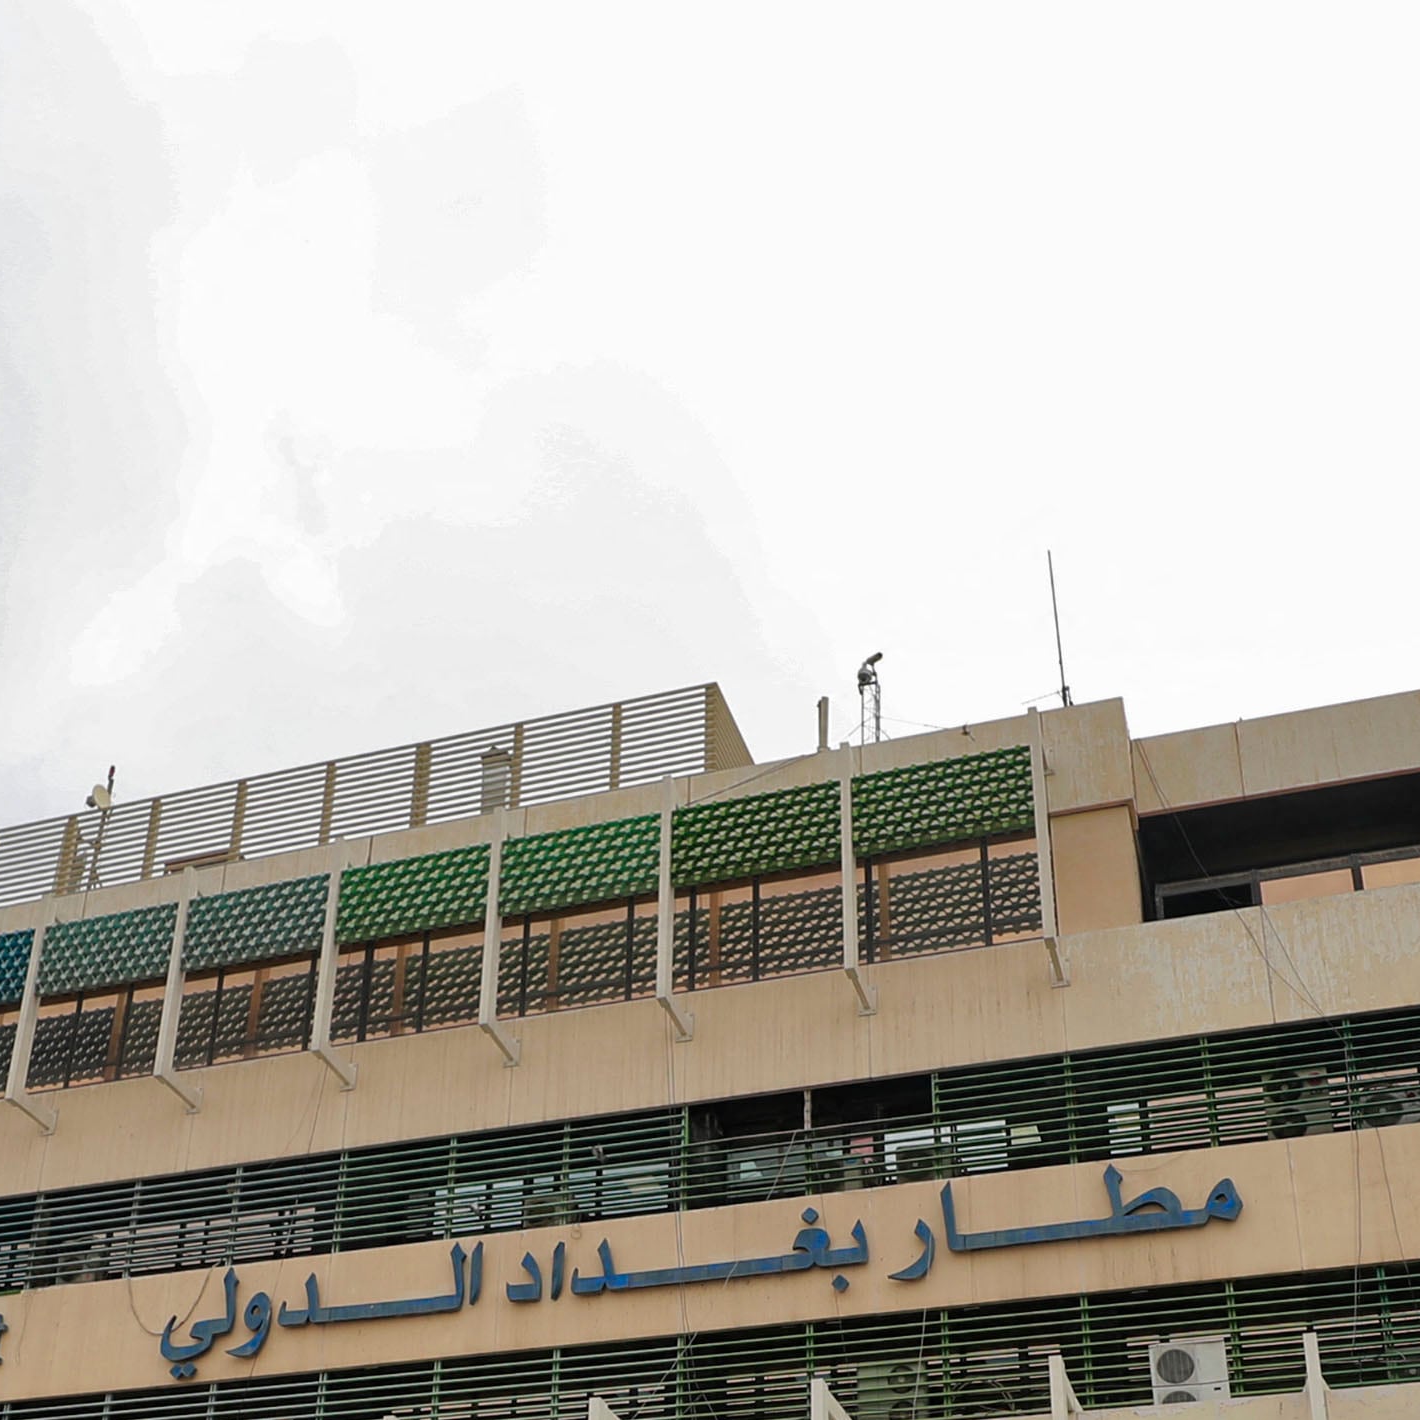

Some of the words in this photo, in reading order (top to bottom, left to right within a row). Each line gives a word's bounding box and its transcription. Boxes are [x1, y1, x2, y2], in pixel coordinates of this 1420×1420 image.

[505, 1205, 871, 1294] بغداد
[885, 1163, 1245, 1283] مطار
[159, 1238, 485, 1380] الدولي
